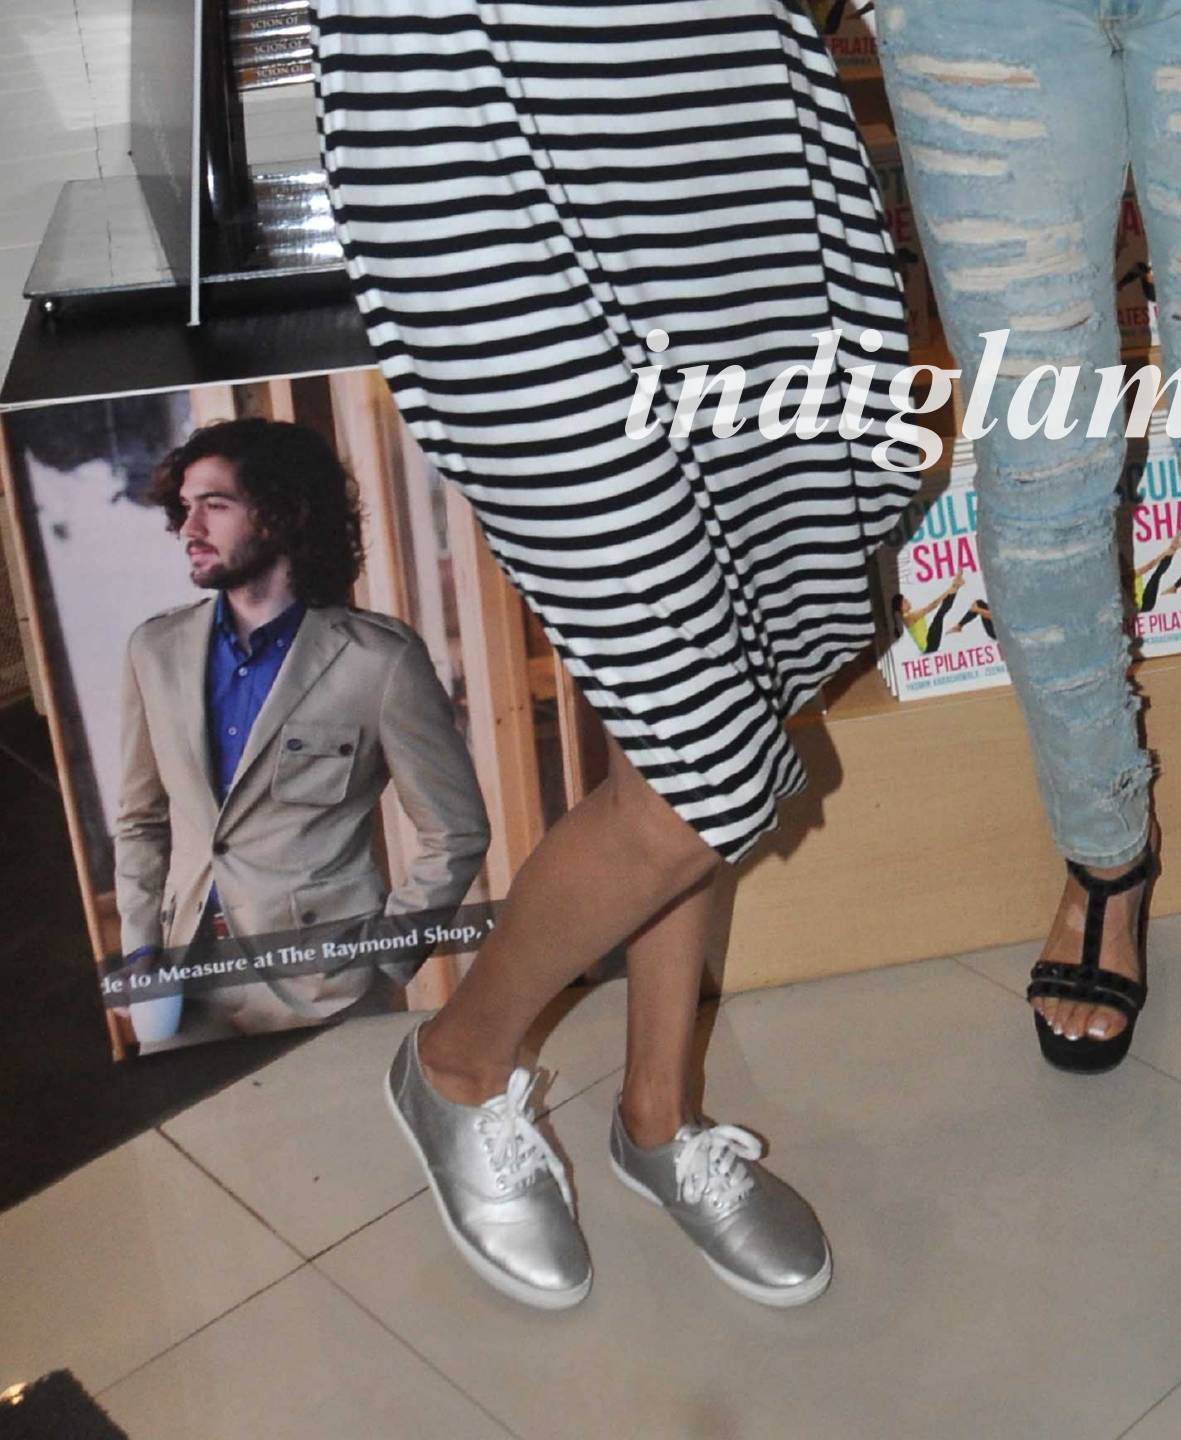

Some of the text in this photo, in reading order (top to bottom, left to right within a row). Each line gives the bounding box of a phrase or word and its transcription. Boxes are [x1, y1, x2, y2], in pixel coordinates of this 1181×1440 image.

[913, 536, 977, 584] SHA
[902, 645, 994, 681] THE PILATES
[130, 972, 151, 989] to
[158, 958, 248, 985] Measure
[254, 952, 275, 969] at
[277, 945, 316, 966] The
[322, 927, 418, 961] Raymond
[424, 923, 483, 946] Shop,
